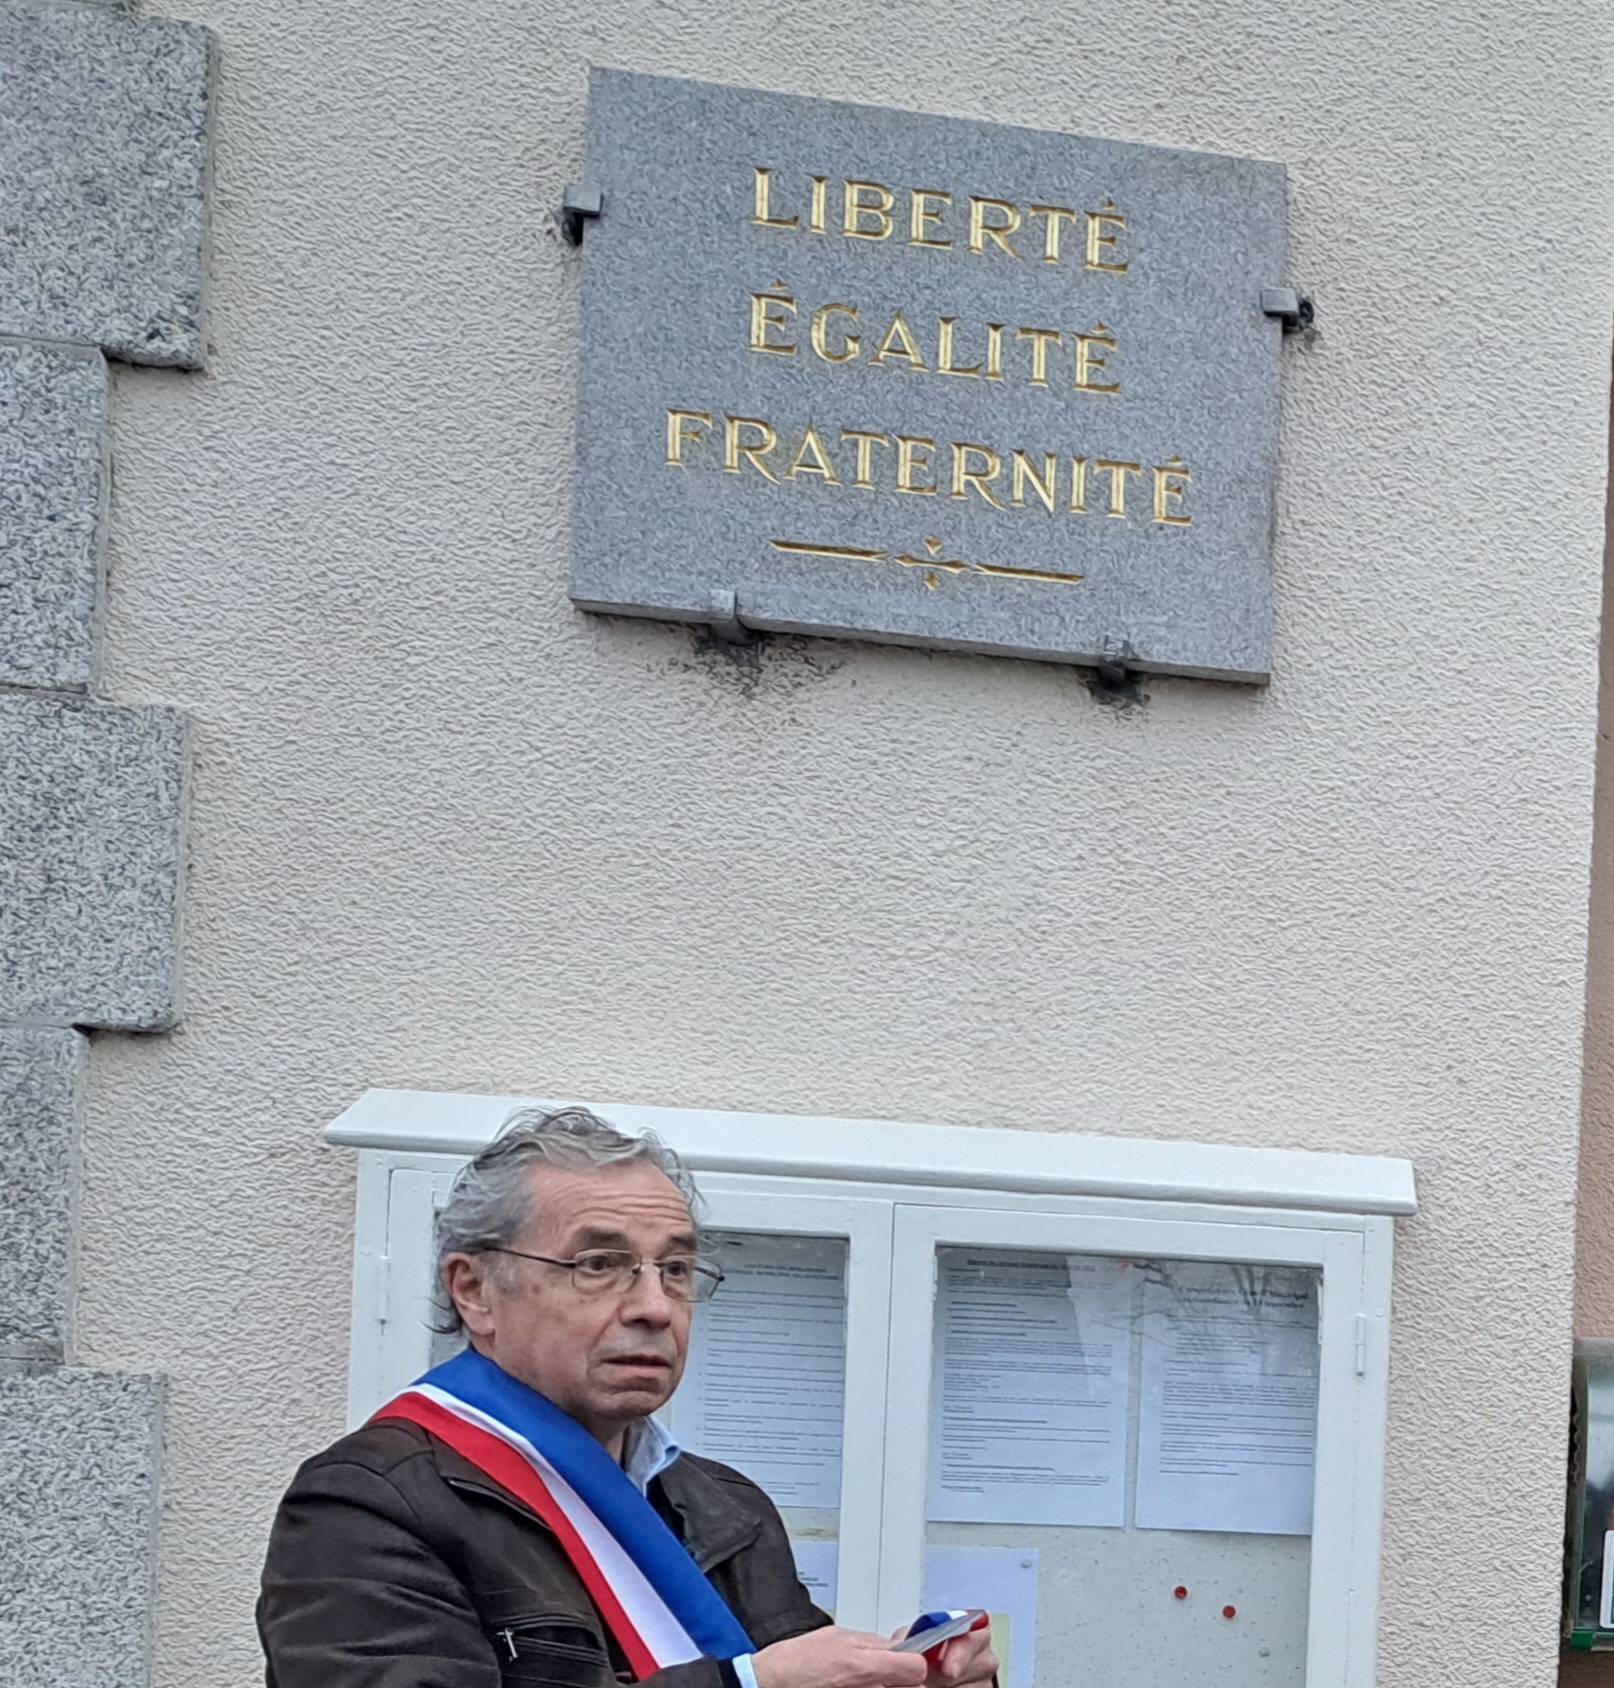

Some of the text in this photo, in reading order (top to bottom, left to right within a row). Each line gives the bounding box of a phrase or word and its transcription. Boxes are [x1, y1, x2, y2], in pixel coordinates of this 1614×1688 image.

[752, 167, 1131, 274] LIBERTÉ
[749, 279, 1121, 395] ÉGALITÉ
[665, 408, 1194, 526] FRATERNITÉ
